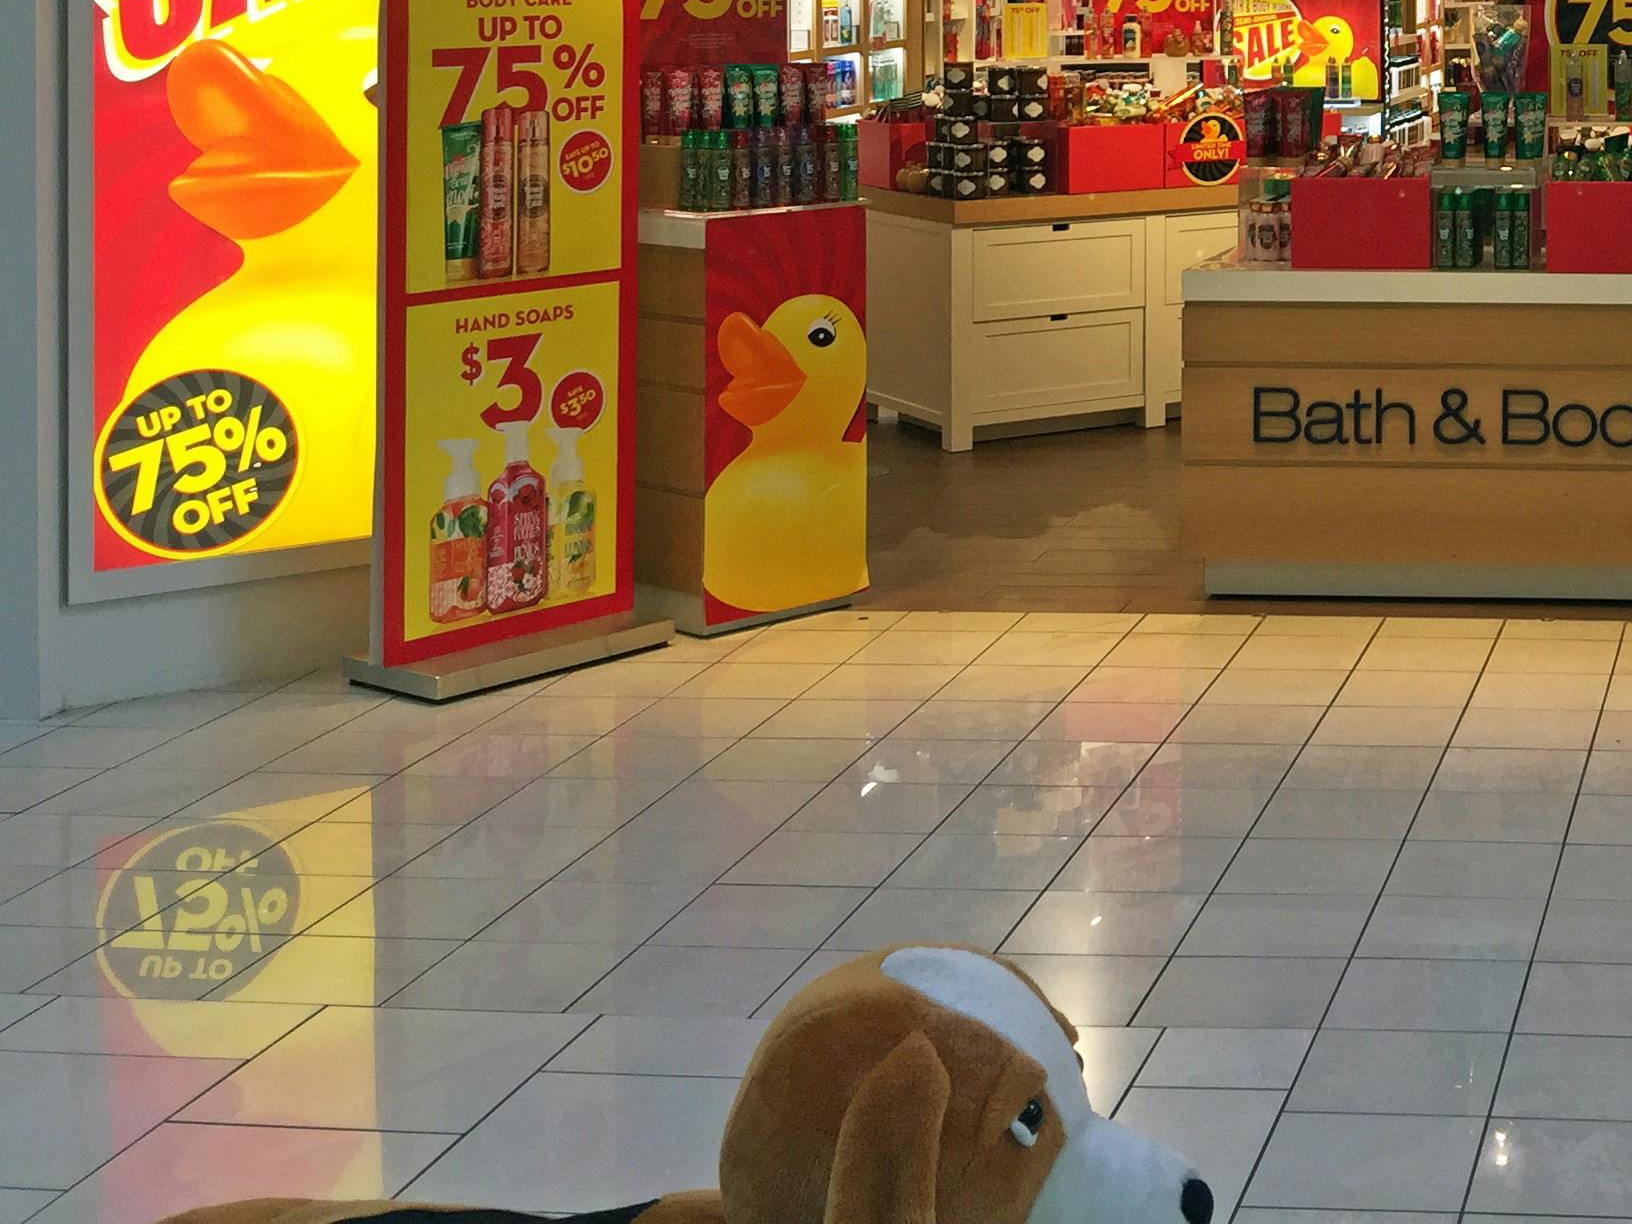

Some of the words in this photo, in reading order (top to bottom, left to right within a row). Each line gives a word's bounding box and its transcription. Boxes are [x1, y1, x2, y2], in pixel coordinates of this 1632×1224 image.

[478, 16, 517, 41] UP
[524, 14, 563, 40] TO
[1232, 20, 1295, 68] SALE
[1579, 49, 1598, 57] OFF
[432, 43, 605, 129] 75%
[552, 95, 605, 122] OFF
[1194, 149, 1228, 160] ONLY!
[456, 312, 510, 333] HAND
[515, 305, 574, 326] SOAPS
[461, 333, 543, 431] $3
[136, 406, 181, 438] UP
[187, 389, 233, 420] TO
[1253, 386, 1415, 446] Bath
[1433, 387, 1485, 446] &
[109, 406, 287, 516] 75%
[173, 478, 259, 534] OFF
